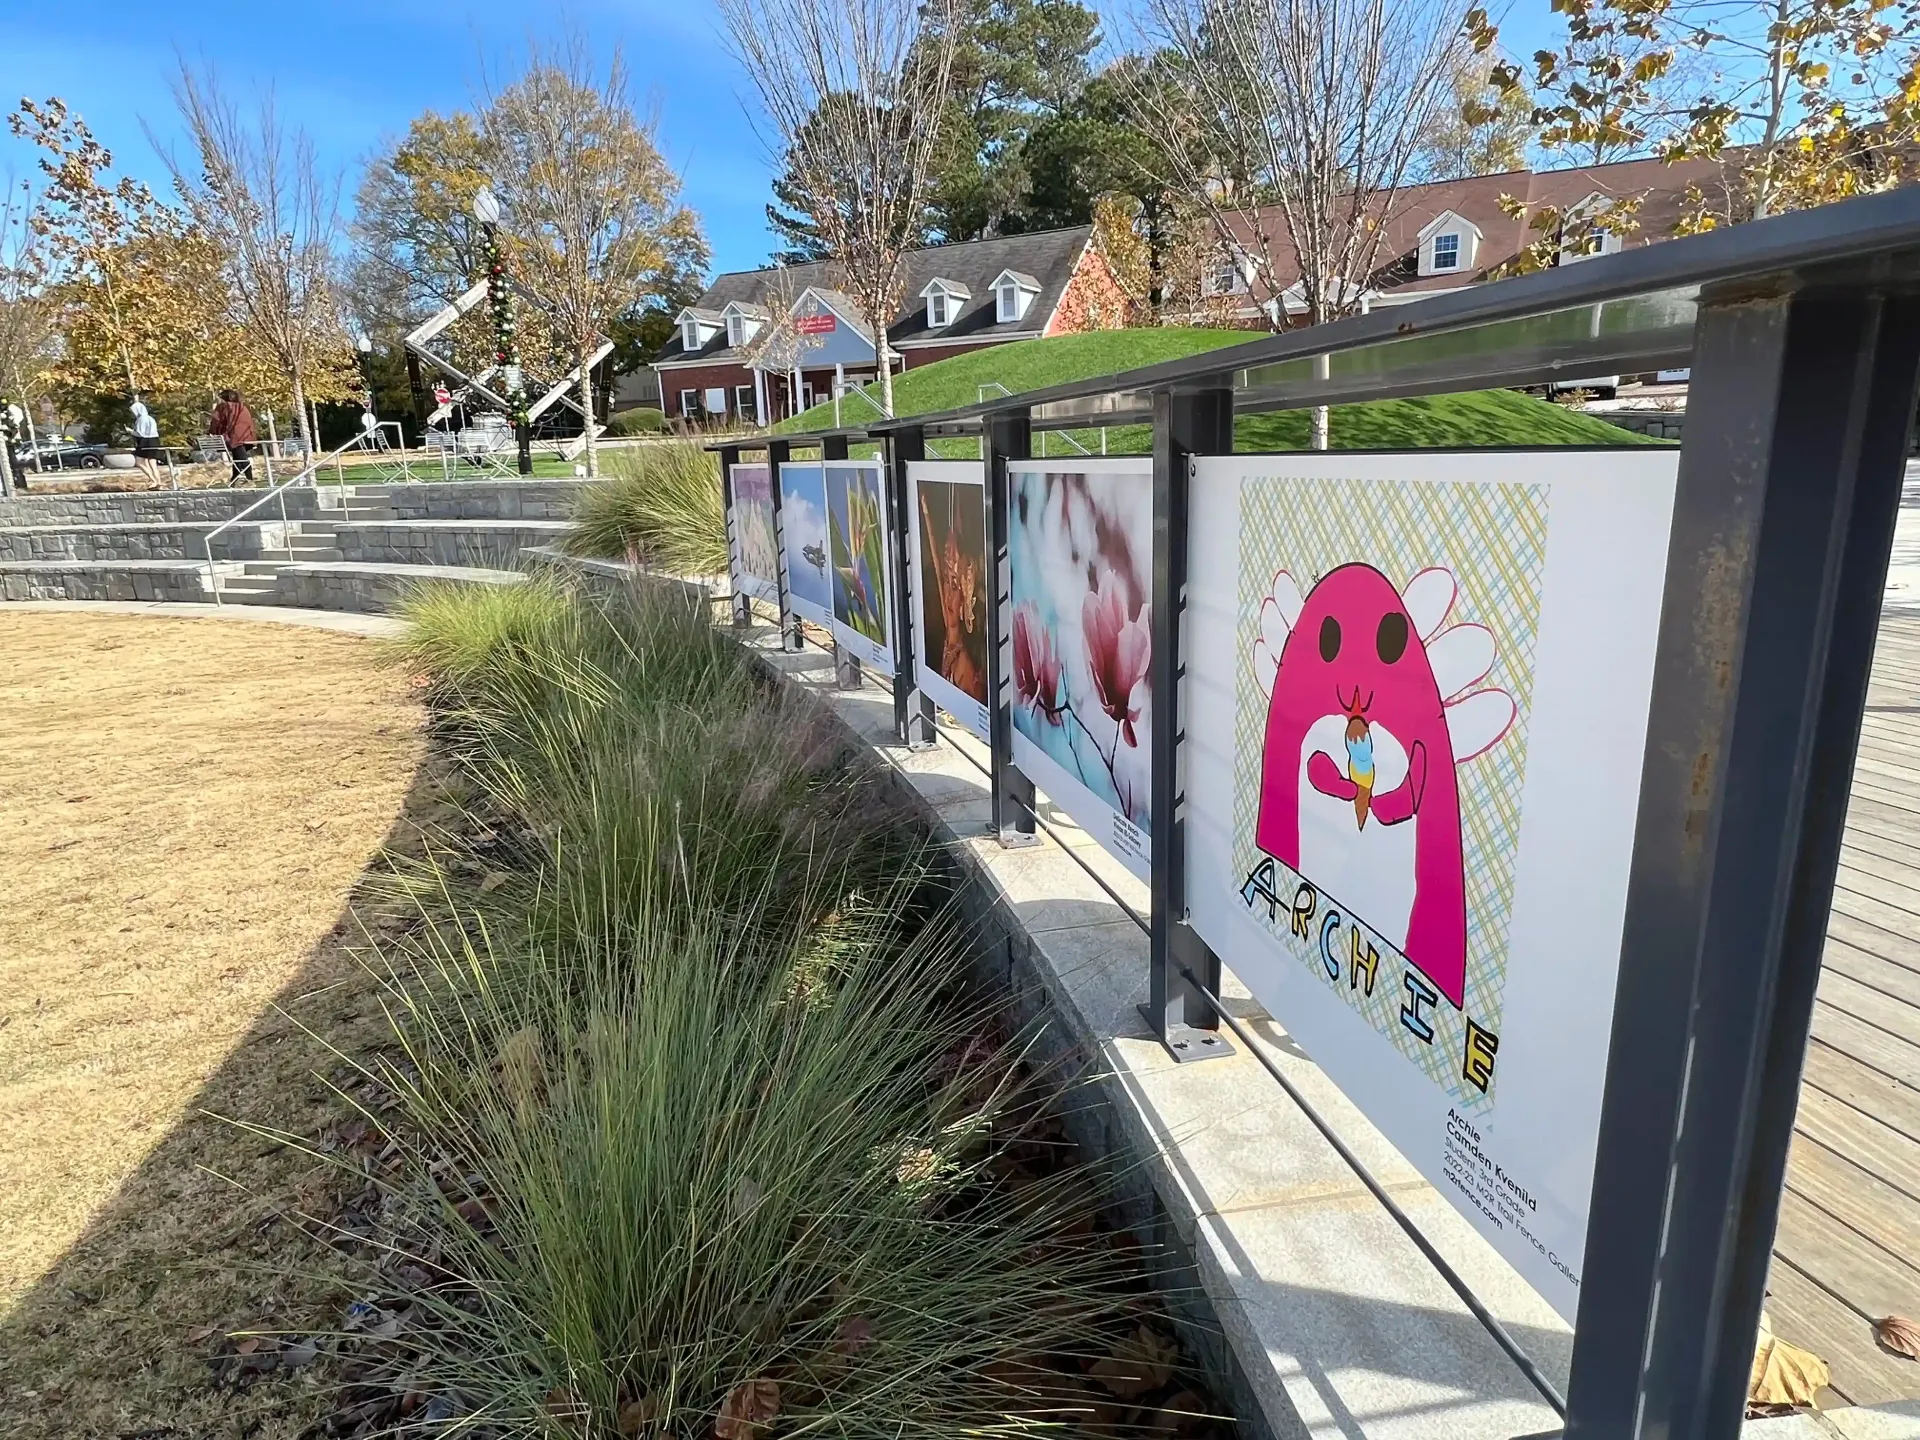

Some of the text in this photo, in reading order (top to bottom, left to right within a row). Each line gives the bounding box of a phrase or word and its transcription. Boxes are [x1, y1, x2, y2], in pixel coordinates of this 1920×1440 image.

[1240, 857, 1499, 1095] ARCHIE
[1447, 1108, 1482, 1143] Archie
[1443, 1167, 1503, 1230] m2rfence.com
[1446, 1121, 1537, 1212] Camden Kvenild
[1479, 1168, 1493, 1188] 3rd
[1495, 1184, 1525, 1217] Grade
[1444, 1150, 1581, 1287] 2022-23 M2R Trail Fence Galler
